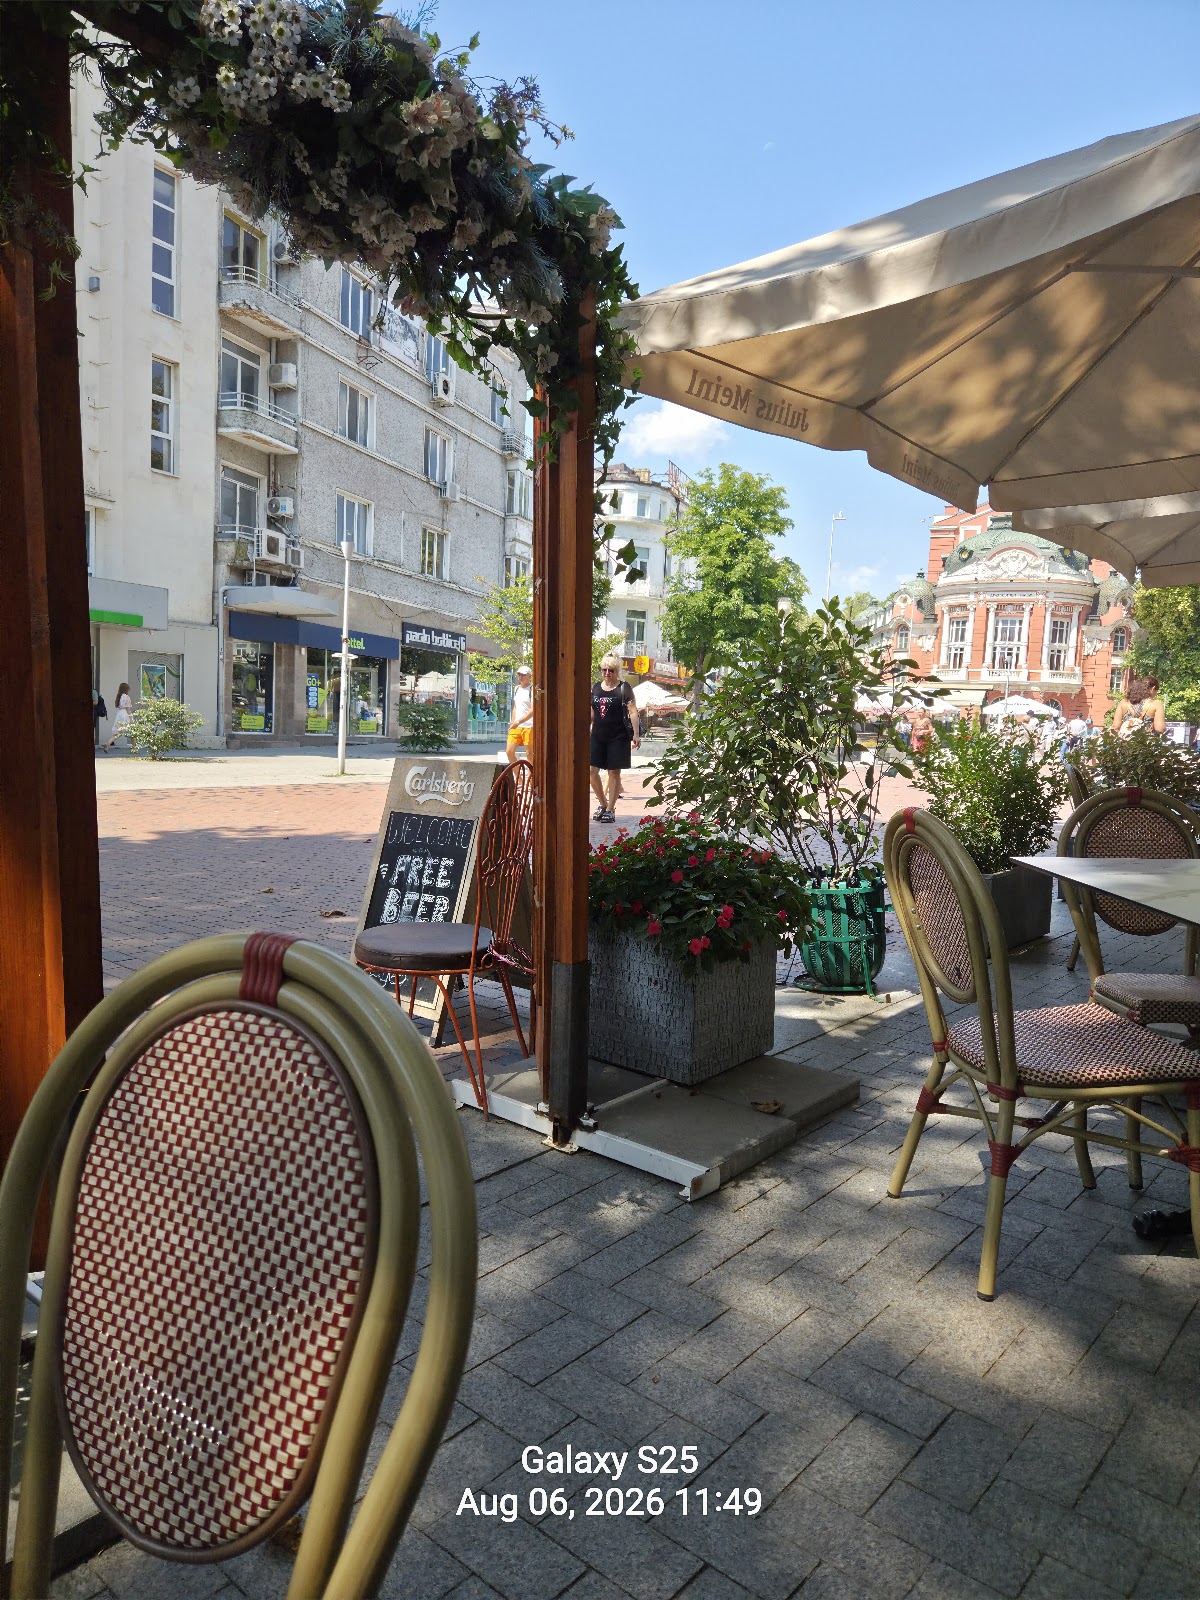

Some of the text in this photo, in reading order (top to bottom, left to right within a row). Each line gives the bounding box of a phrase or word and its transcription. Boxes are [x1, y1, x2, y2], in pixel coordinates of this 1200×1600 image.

[404, 765, 476, 803] Carlsberg
[387, 813, 472, 849] WELCOME
[389, 854, 455, 889] FREE
[379, 887, 450, 924] BEER
